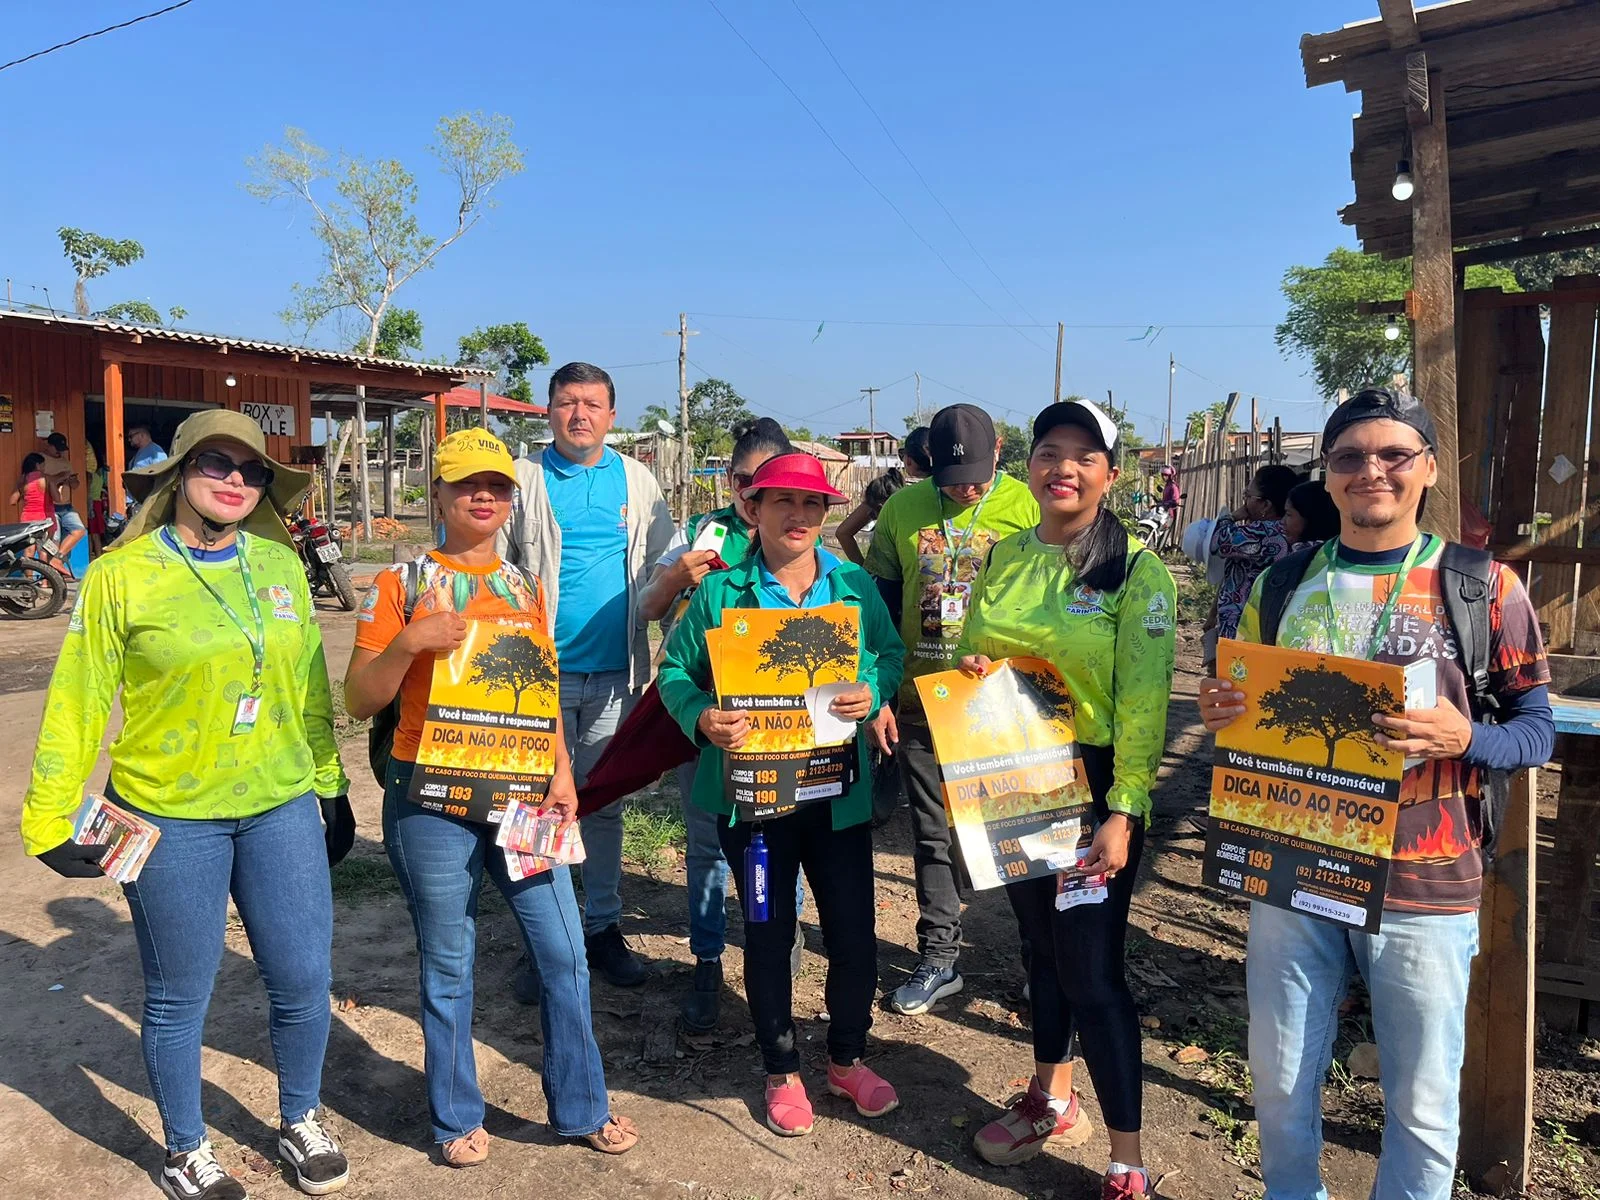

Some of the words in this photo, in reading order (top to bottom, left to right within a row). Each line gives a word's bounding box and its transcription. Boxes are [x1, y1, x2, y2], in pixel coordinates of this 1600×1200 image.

[244, 404, 270, 420] BOX
[260, 420, 286, 436] LLE
[478, 440, 499, 451] VIDA
[732, 697, 753, 707] Você
[755, 697, 792, 707] também
[794, 697, 800, 706] é
[438, 708, 460, 720] Você
[462, 711, 498, 724] também
[499, 715, 505, 724] é
[506, 717, 550, 729] responsável
[765, 712, 792, 730] NÃO
[797, 715, 813, 729] AO
[432, 728, 463, 744] DIGA
[468, 729, 496, 747] NÃO
[500, 734, 516, 748] AO
[520, 736, 550, 752] FOGO
[952, 764, 975, 775] Você
[976, 759, 1014, 773] também
[1014, 756, 1020, 765] é
[1020, 746, 1071, 764] responsável
[755, 770, 777, 783] 193
[810, 763, 843, 775] 2123-6729
[1228, 752, 1254, 768] Você
[1256, 759, 1304, 777] também
[1306, 767, 1314, 778] é
[1316, 772, 1385, 794] responsável
[449, 786, 472, 800] 193
[736, 788, 754, 796] POLÍCIA
[957, 778, 989, 801] DIGA
[991, 774, 1019, 795] NÃO
[492, 792, 506, 802] (92)
[508, 792, 544, 802] 2123-6729
[754, 790, 777, 804] 190
[1223, 774, 1261, 798] DIGA
[1267, 782, 1301, 807] NÃO
[1306, 792, 1330, 814] AO
[1336, 798, 1384, 825] FOGO
[444, 804, 468, 816] 190
[1001, 820, 1016, 828] FOCO
[998, 838, 1021, 855] 193
[1220, 822, 1229, 830] EM
[1230, 824, 1249, 835] CASO
[1250, 829, 1260, 838] DE
[1261, 832, 1279, 842] FOCO
[1280, 837, 1290, 845] DE
[1291, 839, 1328, 856] QUEIMADA,
[1330, 850, 1352, 861] LIGUE
[1354, 855, 1378, 867] PARA:
[1221, 842, 1238, 854] CORPO
[1239, 846, 1246, 856] DE
[1216, 850, 1245, 864] BOMBEIROS
[1248, 850, 1273, 871] 193
[1004, 860, 1028, 877] 190
[1318, 859, 1350, 873] IPAAM
[1219, 876, 1241, 889] MILITAR
[1220, 868, 1242, 881] POLÍCIA
[1296, 865, 1312, 879] (92)
[1315, 869, 1371, 893] 2123-6729
[1244, 875, 1268, 896] 190
[1298, 901, 1311, 909] (92)
[1312, 904, 1350, 919] 99315-3239
